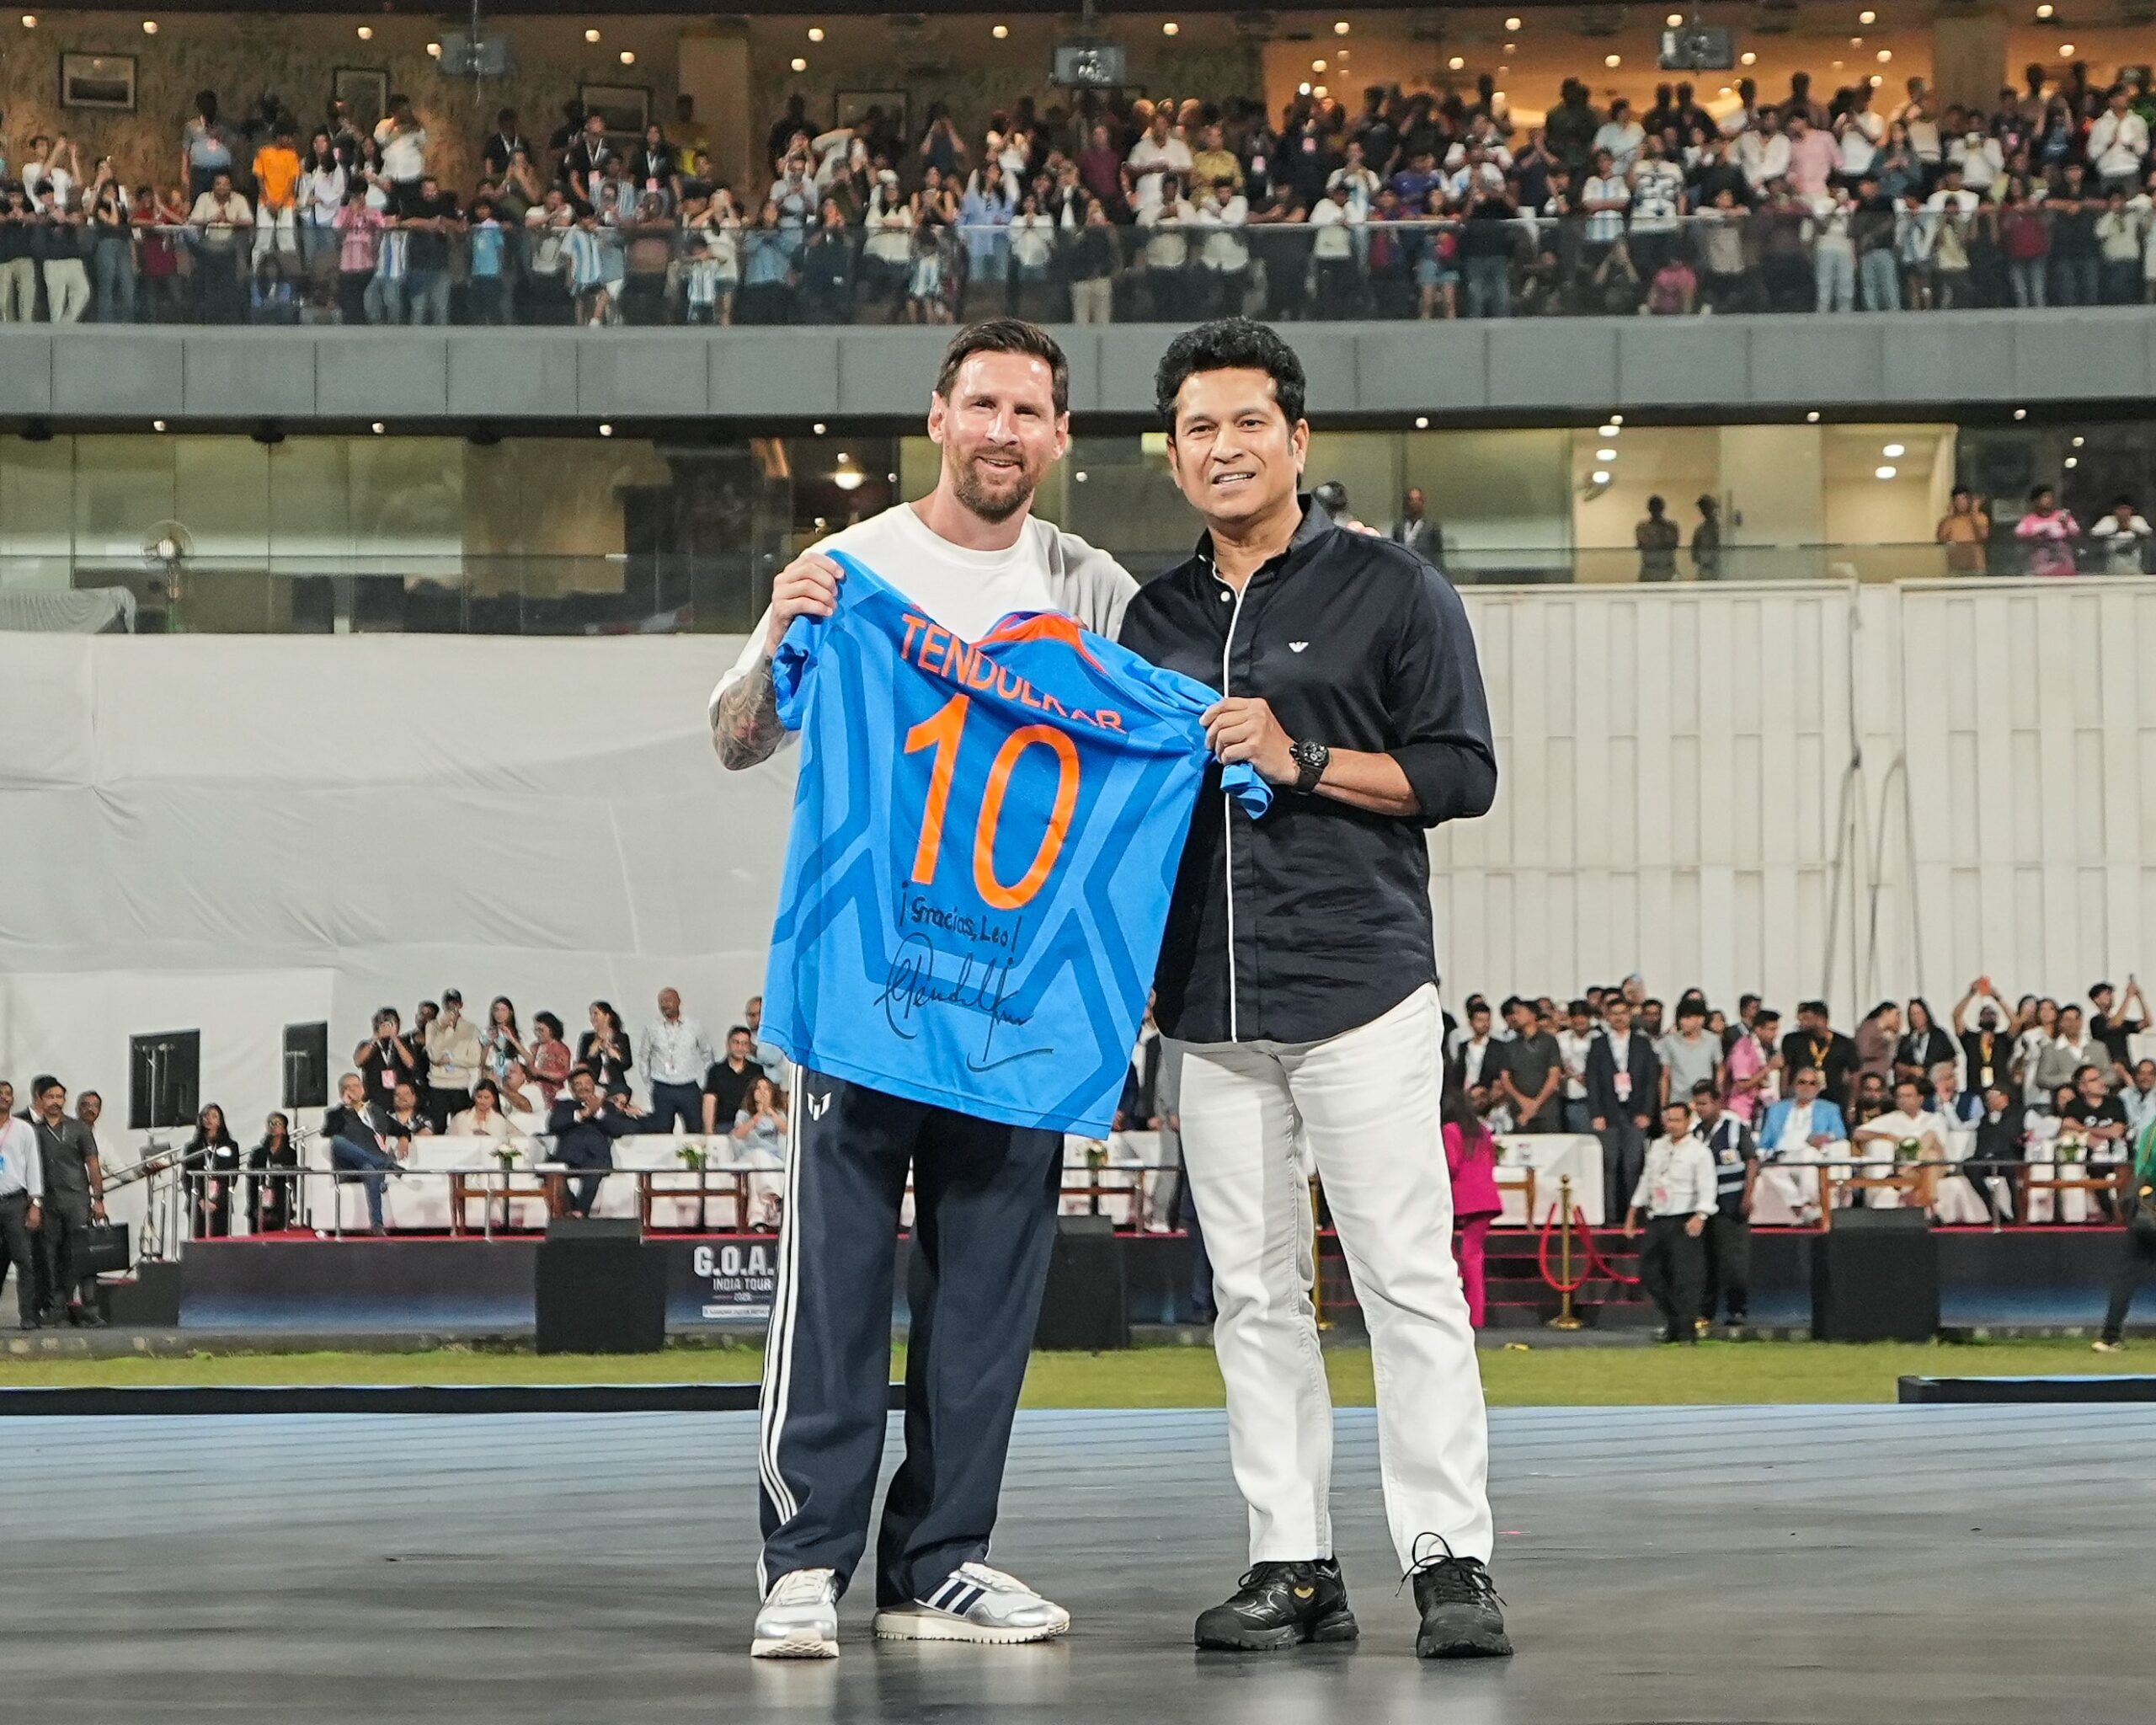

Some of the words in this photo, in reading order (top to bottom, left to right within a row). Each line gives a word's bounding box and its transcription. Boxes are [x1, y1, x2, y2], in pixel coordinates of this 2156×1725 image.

[904, 692, 1081, 910] 10
[693, 1246, 777, 1277] G.O.A.
[712, 1278, 742, 1291] INDIA
[744, 1278, 773, 1291] TOUR
